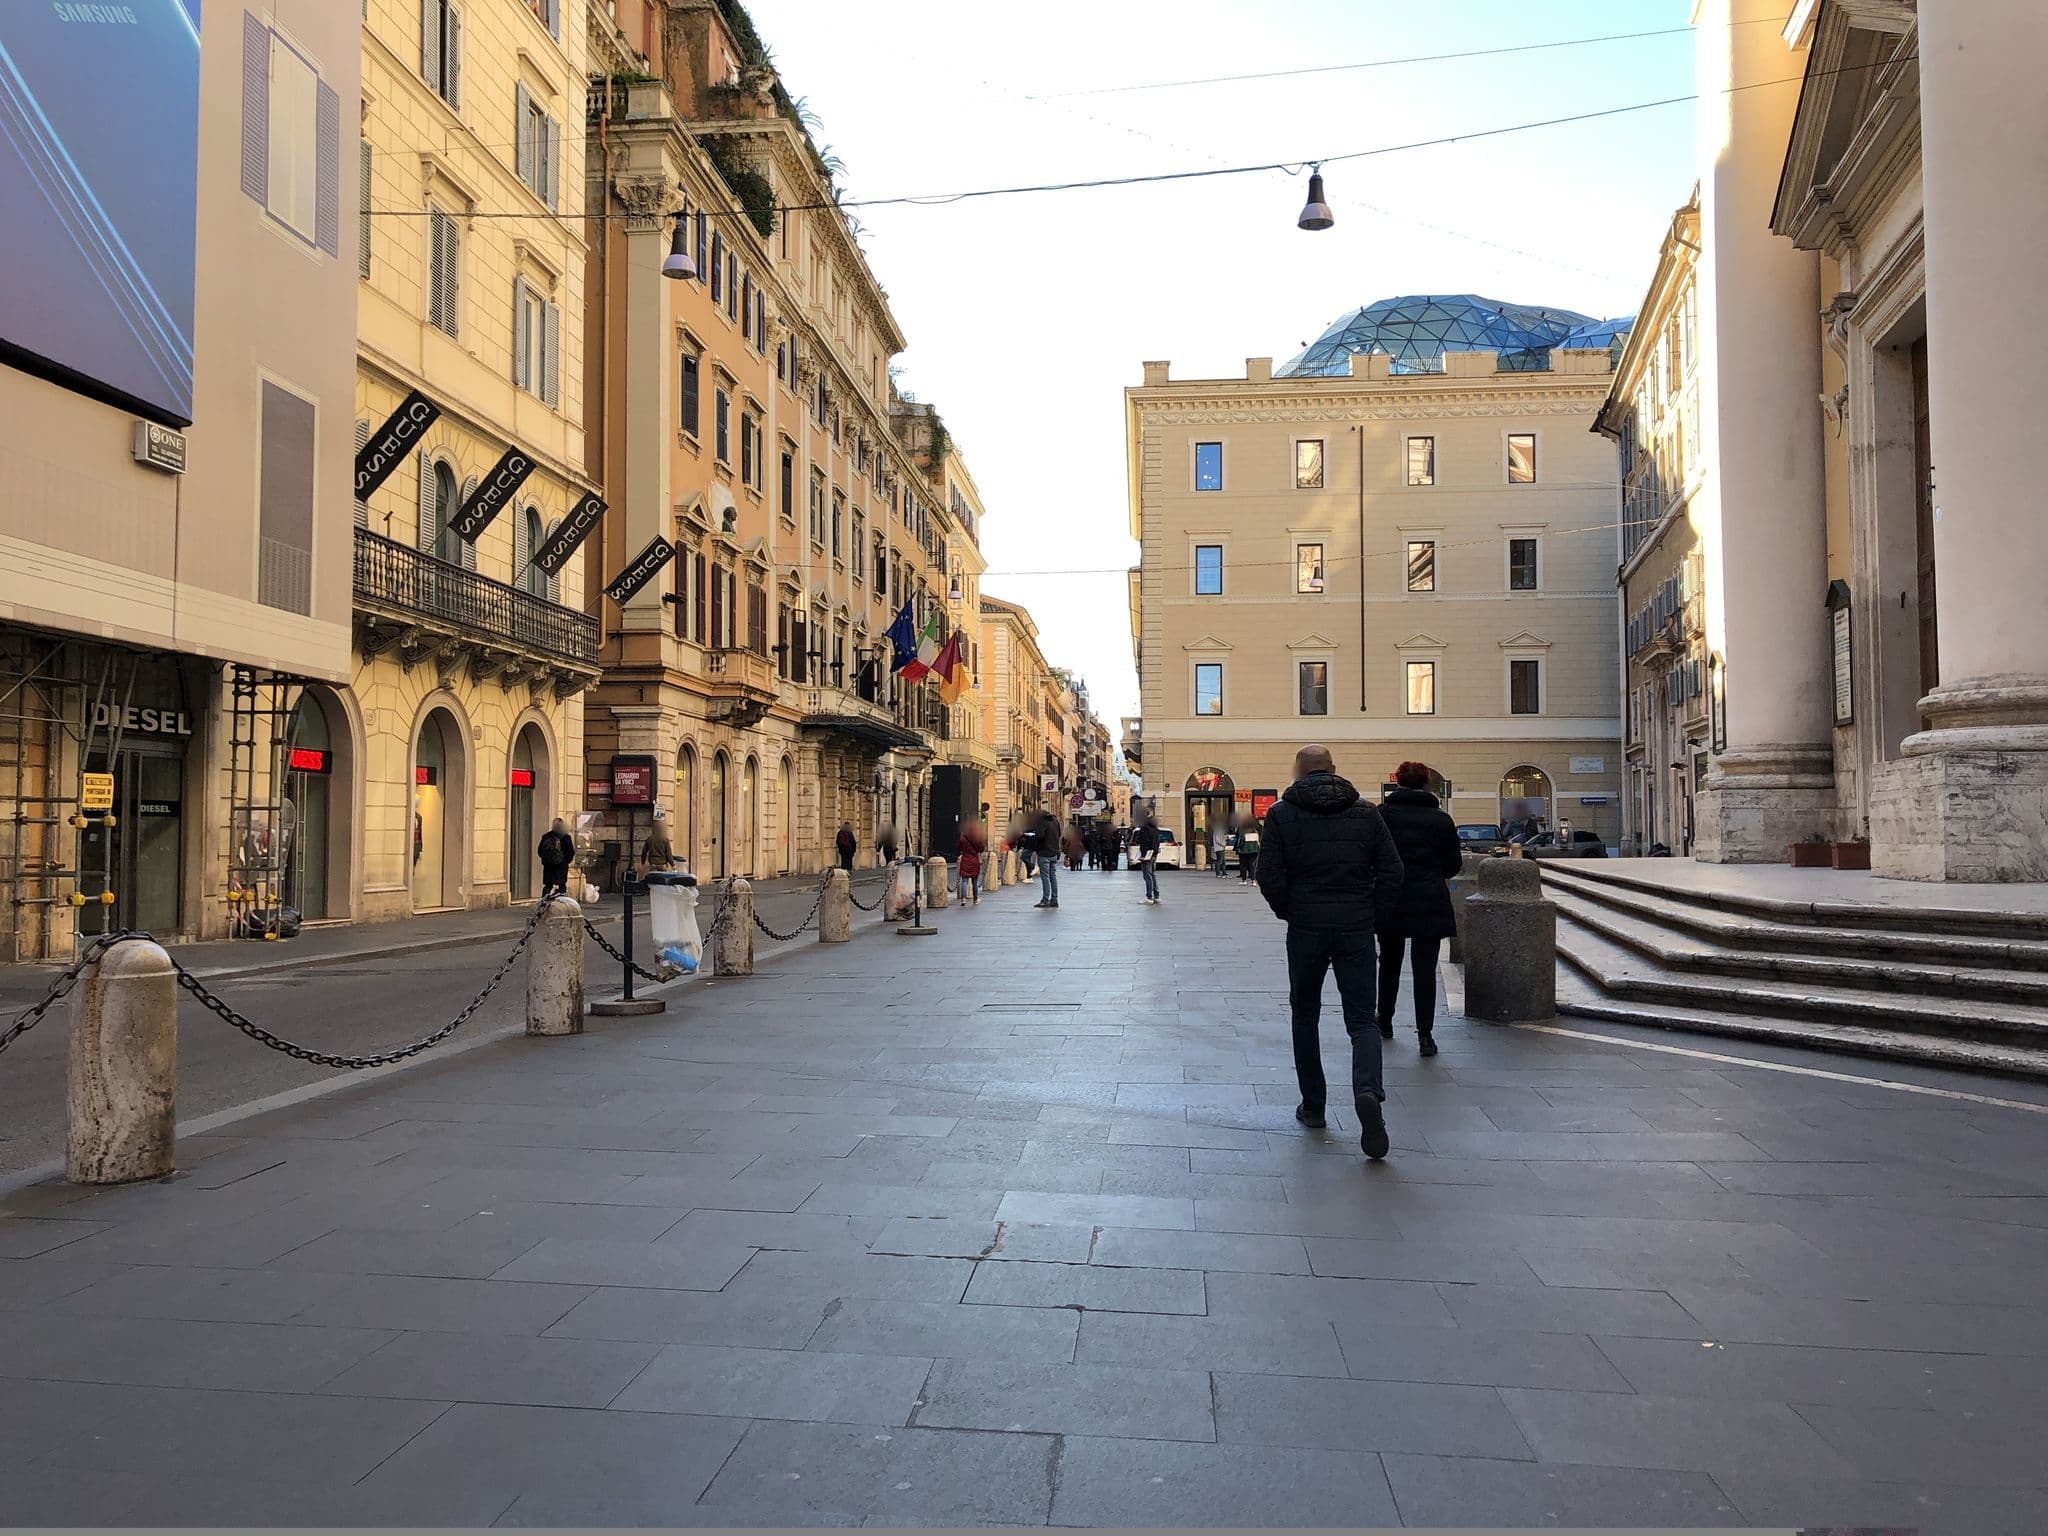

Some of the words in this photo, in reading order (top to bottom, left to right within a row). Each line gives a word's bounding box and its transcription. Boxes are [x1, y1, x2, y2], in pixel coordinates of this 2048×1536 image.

[54, 2, 137, 24] SAMSUNG
[161, 432, 183, 450] ONE
[355, 402, 430, 490] GUESS
[459, 456, 526, 534] GUESS
[541, 500, 601, 568] GUESS
[610, 543, 670, 600] GUESS
[91, 702, 192, 735] DIESEL
[140, 804, 170, 813] DIESEL
[1236, 792, 1251, 800] TAXI
